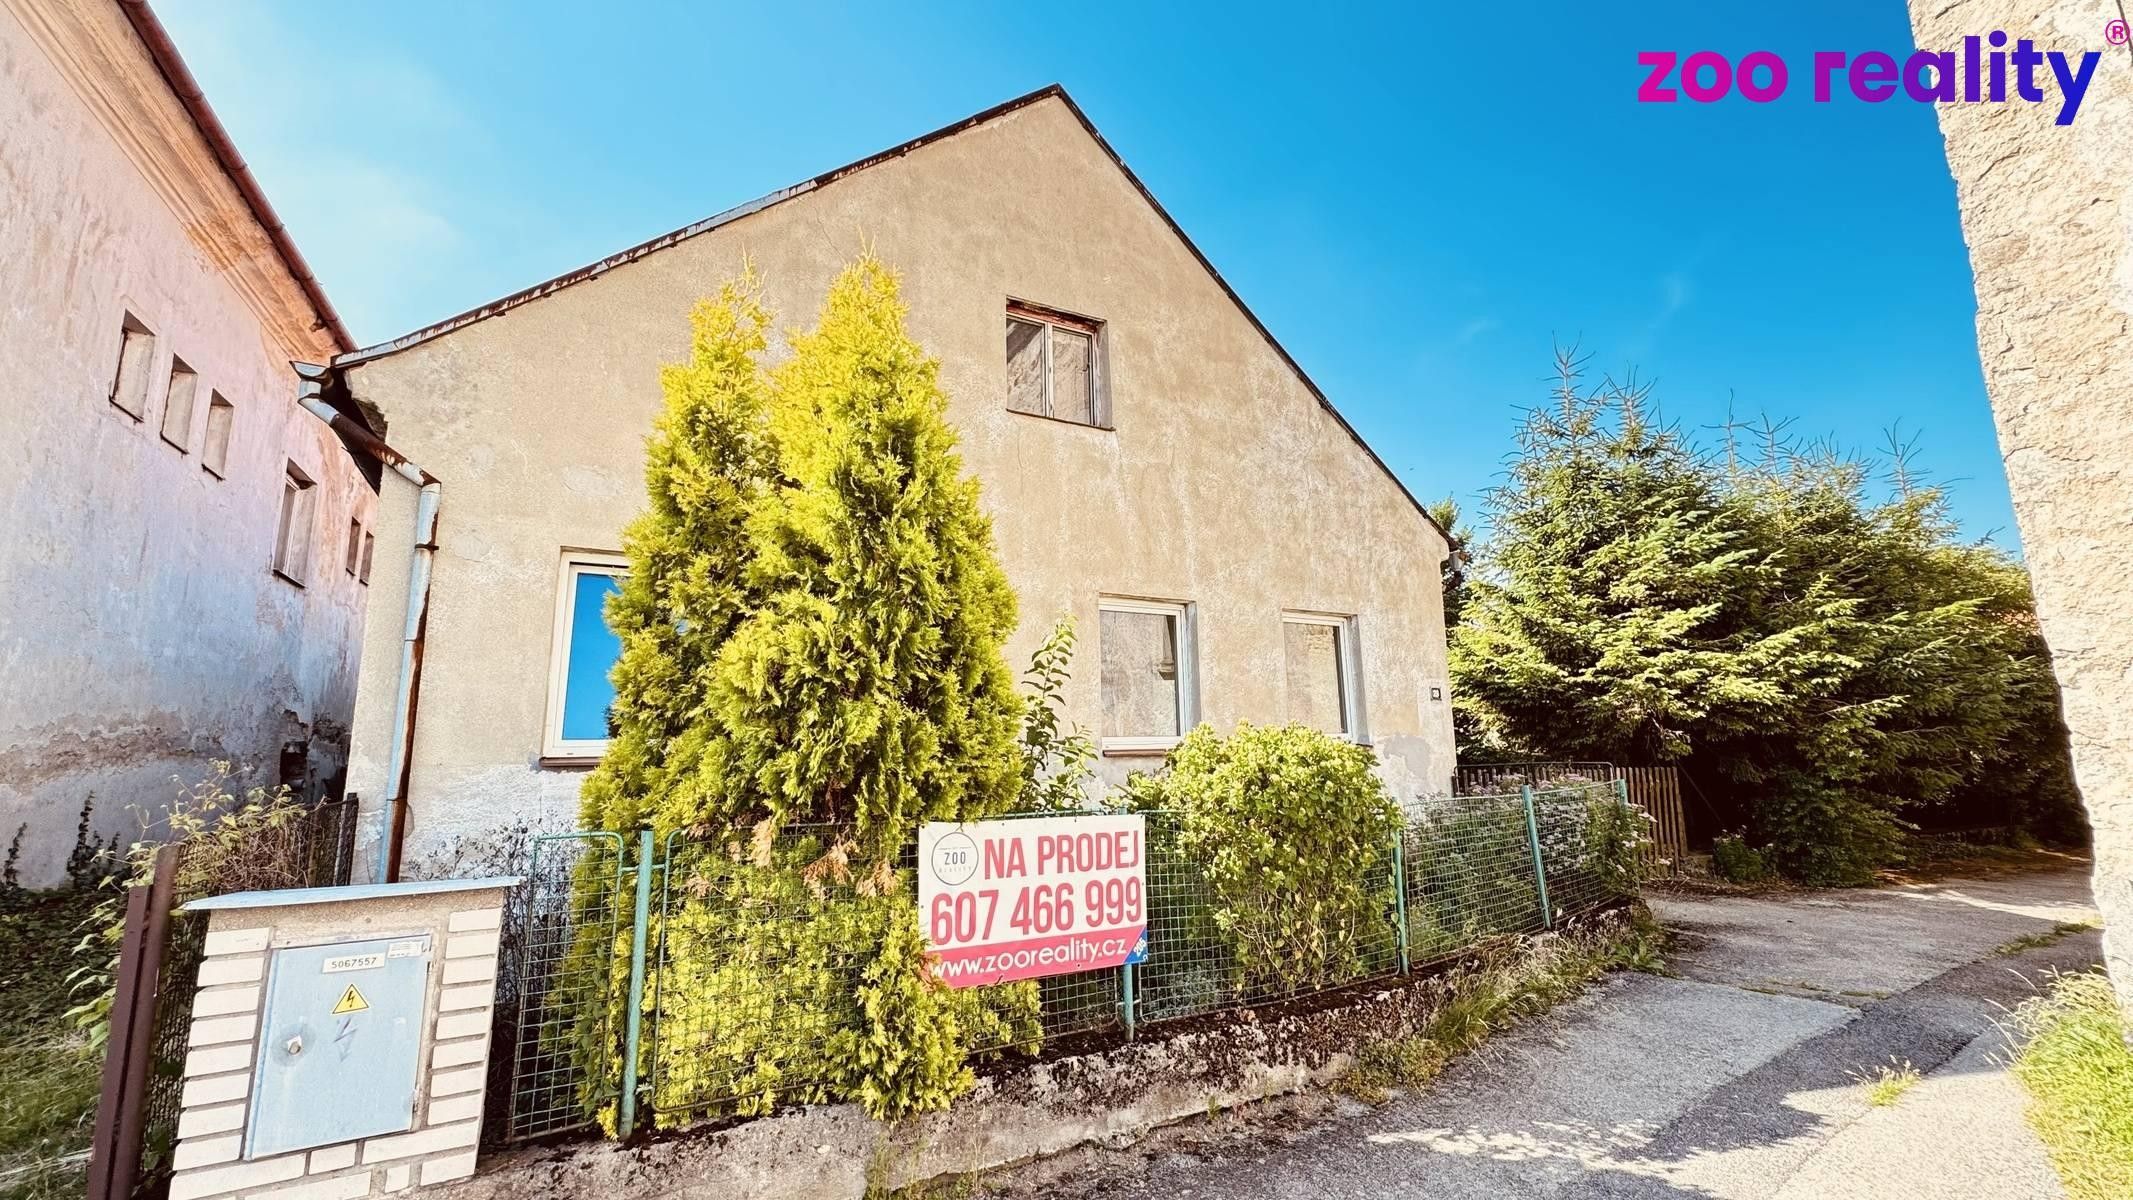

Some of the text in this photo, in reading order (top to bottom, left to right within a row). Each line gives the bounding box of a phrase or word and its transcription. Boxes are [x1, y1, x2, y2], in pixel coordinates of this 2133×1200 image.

[944, 851, 966, 865] ZOO
[984, 830, 1139, 880] NA PRODEJ
[930, 876, 1142, 946] 607 466 999
[331, 957, 377, 969] 5067557
[930, 937, 1127, 978] www.zooreality.cz
